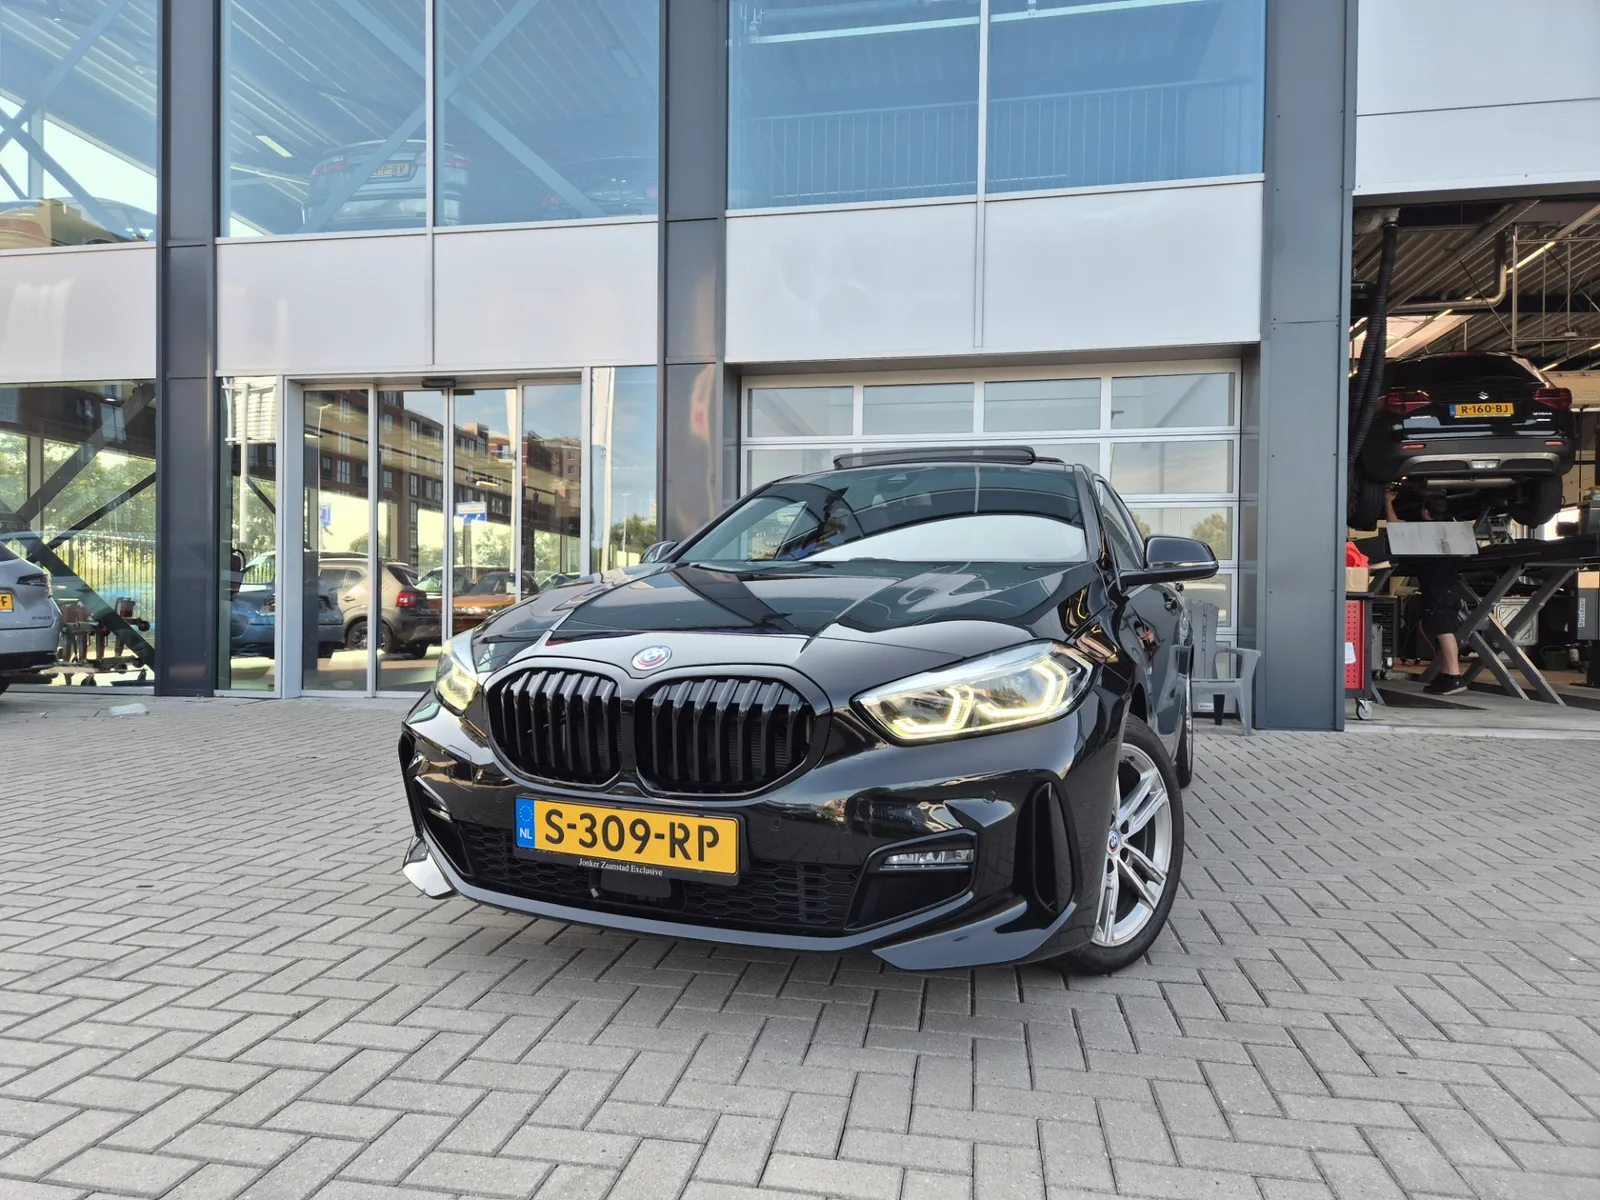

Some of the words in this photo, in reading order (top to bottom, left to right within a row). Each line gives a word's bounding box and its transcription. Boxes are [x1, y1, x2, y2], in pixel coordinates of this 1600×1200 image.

[1461, 404, 1509, 414] R-160-BJ
[519, 827, 533, 840] NL
[545, 808, 720, 862] S-309-RP
[578, 857, 600, 868] Jonker
[600, 861, 630, 872] Zaanstad
[630, 864, 663, 876] Exclusive
